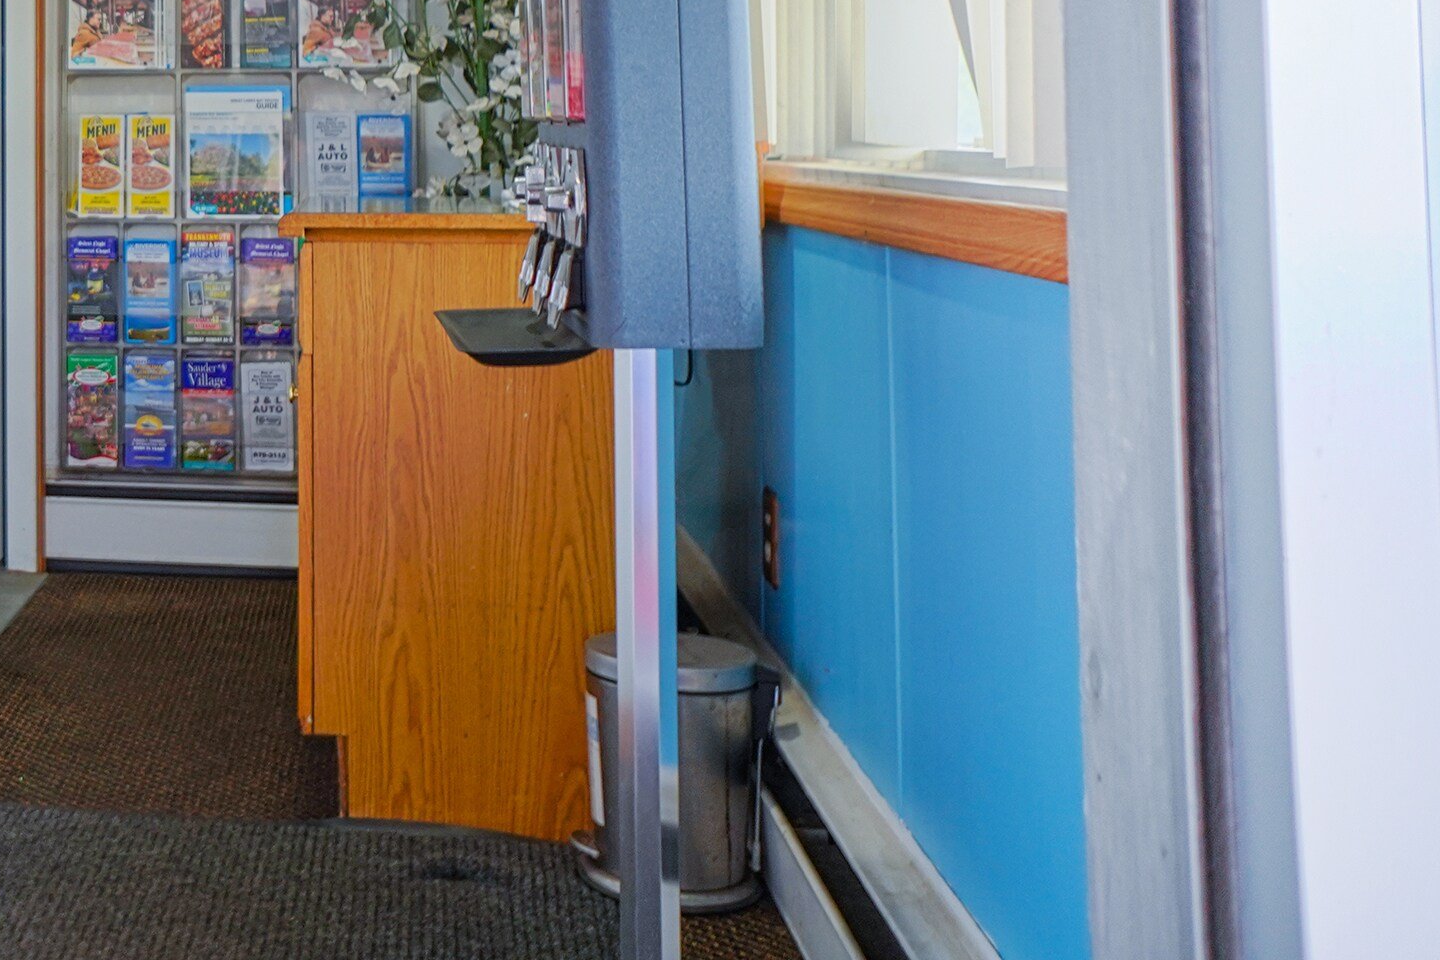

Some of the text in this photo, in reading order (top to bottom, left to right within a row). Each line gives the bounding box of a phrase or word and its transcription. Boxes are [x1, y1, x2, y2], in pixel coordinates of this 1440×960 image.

[256, 102, 278, 110] GUIDE
[87, 123, 116, 139] MENU
[137, 123, 166, 138] MENU
[318, 143, 347, 151] J & L
[318, 152, 348, 160] AUTO
[187, 362, 216, 373] Sauder
[188, 372, 227, 388] Village
[254, 395, 282, 404] J & L
[253, 405, 283, 413] AUTO
